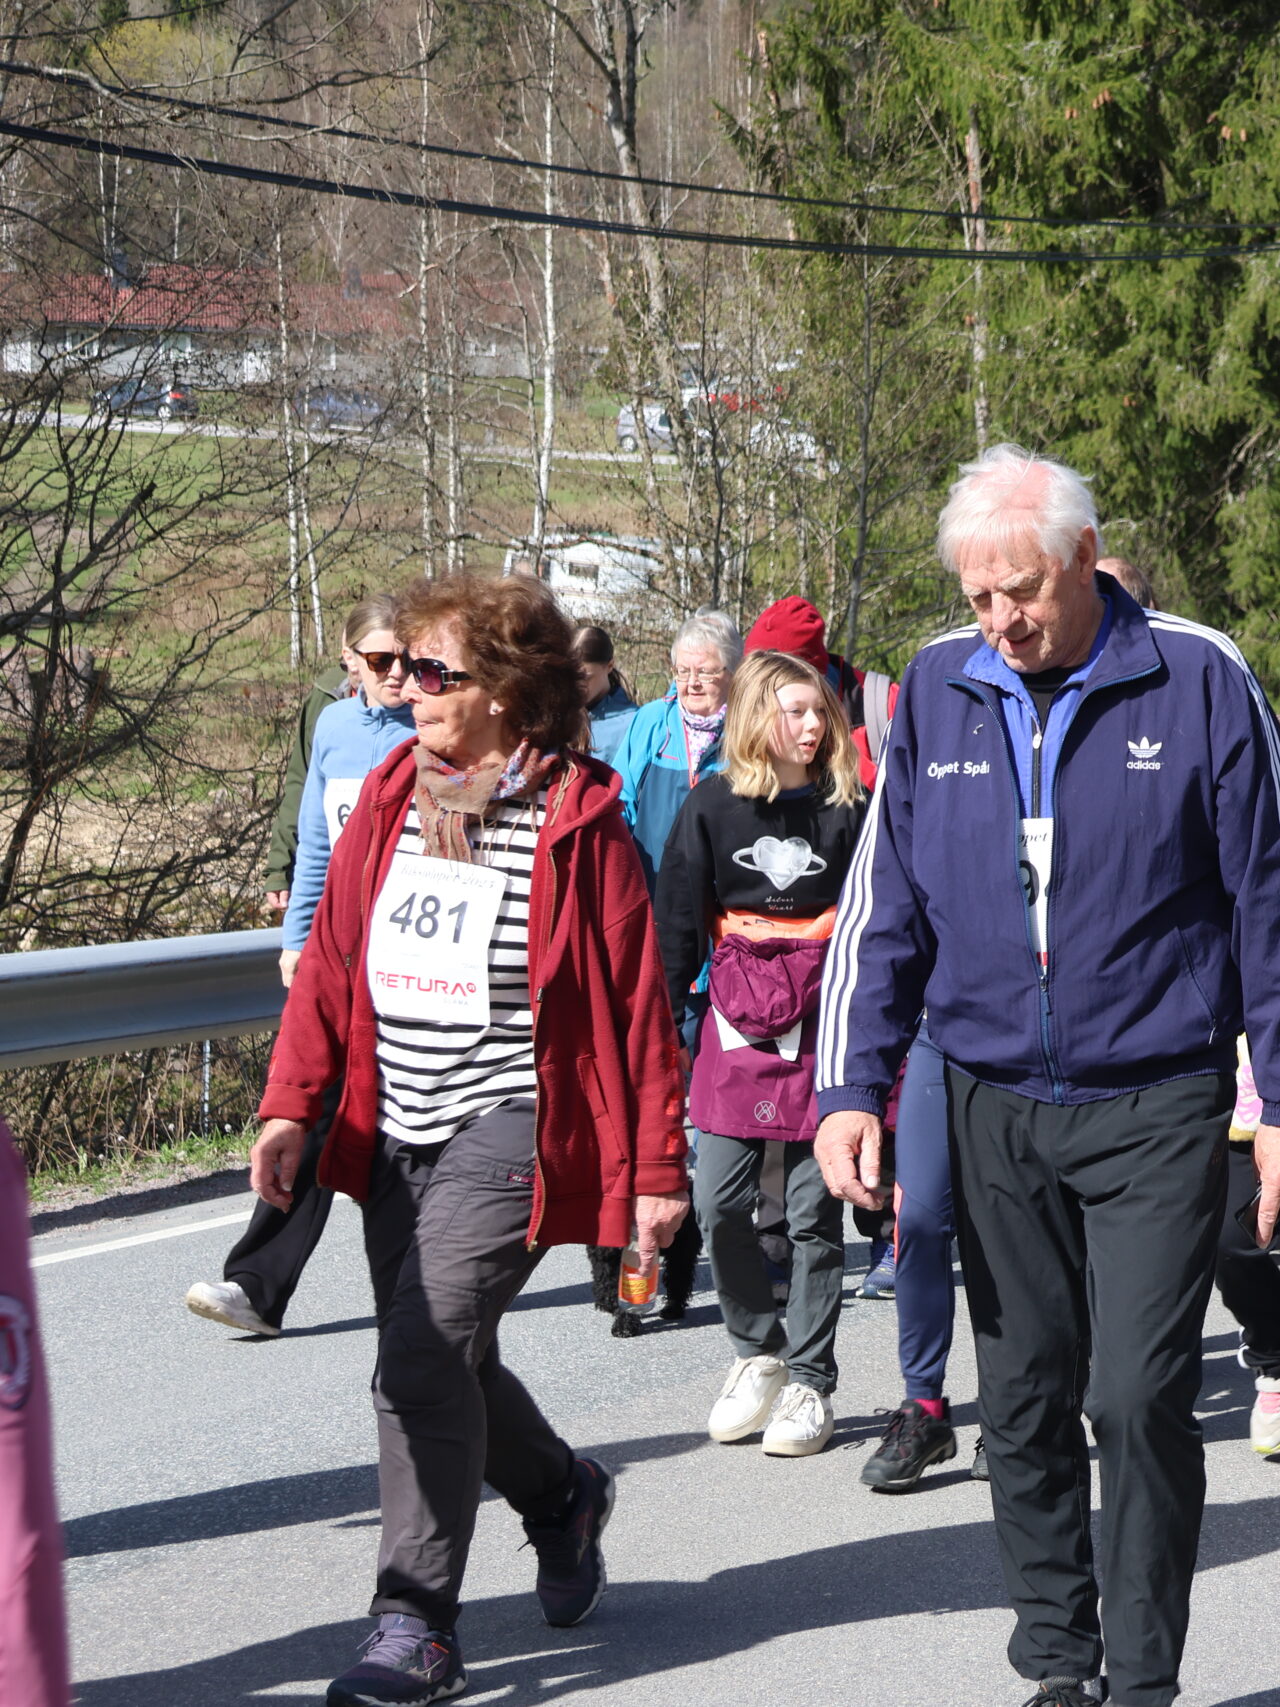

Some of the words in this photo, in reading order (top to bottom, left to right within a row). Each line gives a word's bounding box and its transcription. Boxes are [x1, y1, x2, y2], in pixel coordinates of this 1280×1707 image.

[1126, 760, 1161, 770] adidas
[389, 892, 469, 944] 481
[376, 971, 468, 997] RETURA
